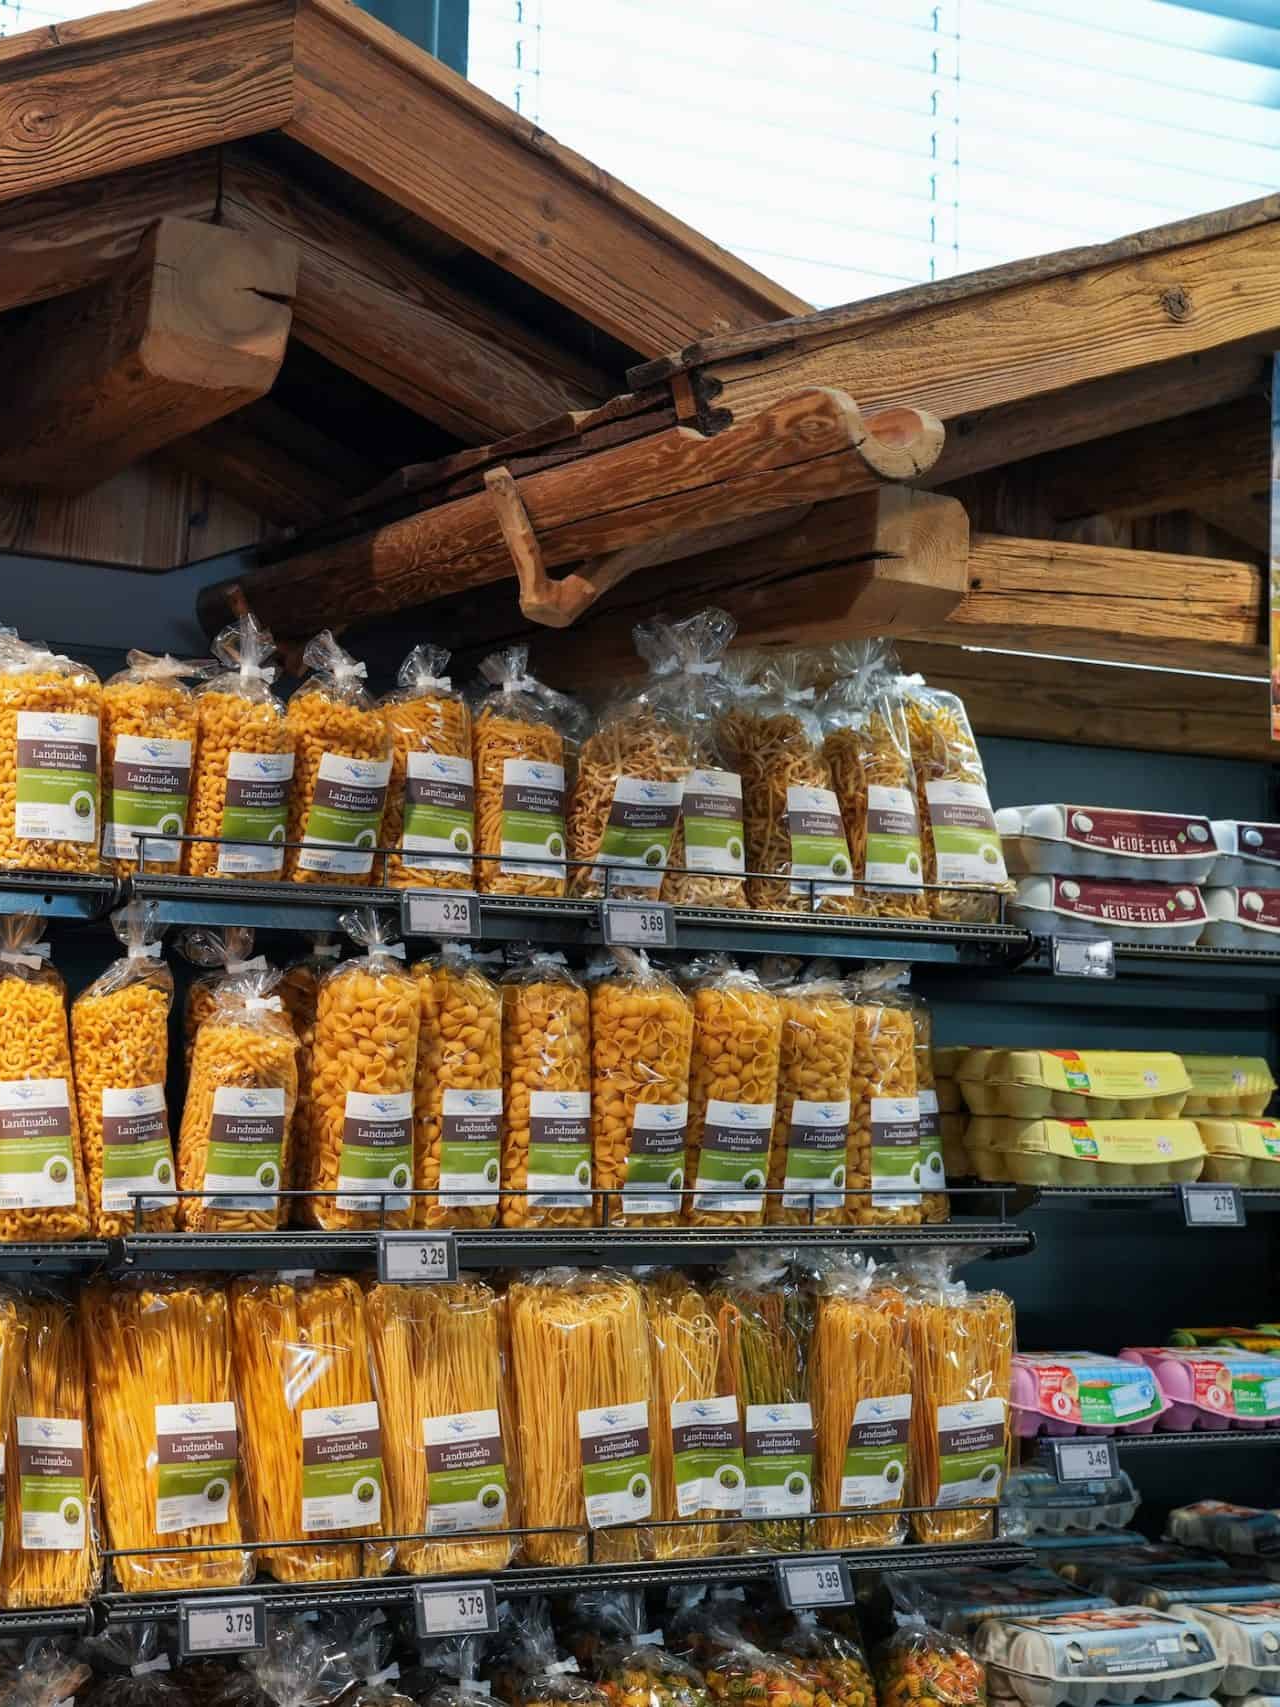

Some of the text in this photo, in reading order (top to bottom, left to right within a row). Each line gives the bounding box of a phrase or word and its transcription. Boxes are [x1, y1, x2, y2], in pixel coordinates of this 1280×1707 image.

[31, 748, 88, 762] Landnudeln
[127, 771, 180, 786] Landnudeln
[328, 789, 378, 805] Landnudeln
[1111, 835, 1178, 853] WEIDE-EIER
[1100, 903, 1167, 921] WEIDE-EIER
[1, 1116, 59, 1130] Landnudeln
[117, 1120, 164, 1136] Landnudeln
[225, 1124, 274, 1135] Landnudeln
[455, 1123, 497, 1134] Landnudeln
[544, 1124, 586, 1135] Landnudeln
[358, 1127, 405, 1139] Landnudeln
[683, 1431, 733, 1442] Landnudeln
[756, 1438, 801, 1449] Landnudeln
[171, 1441, 224, 1453] Landnudeln
[316, 1440, 368, 1455] Landnudeln
[594, 1438, 640, 1454] Landnudeln
[30, 1455, 73, 1467] Landnudeln
[440, 1448, 490, 1462] Landnudeln
